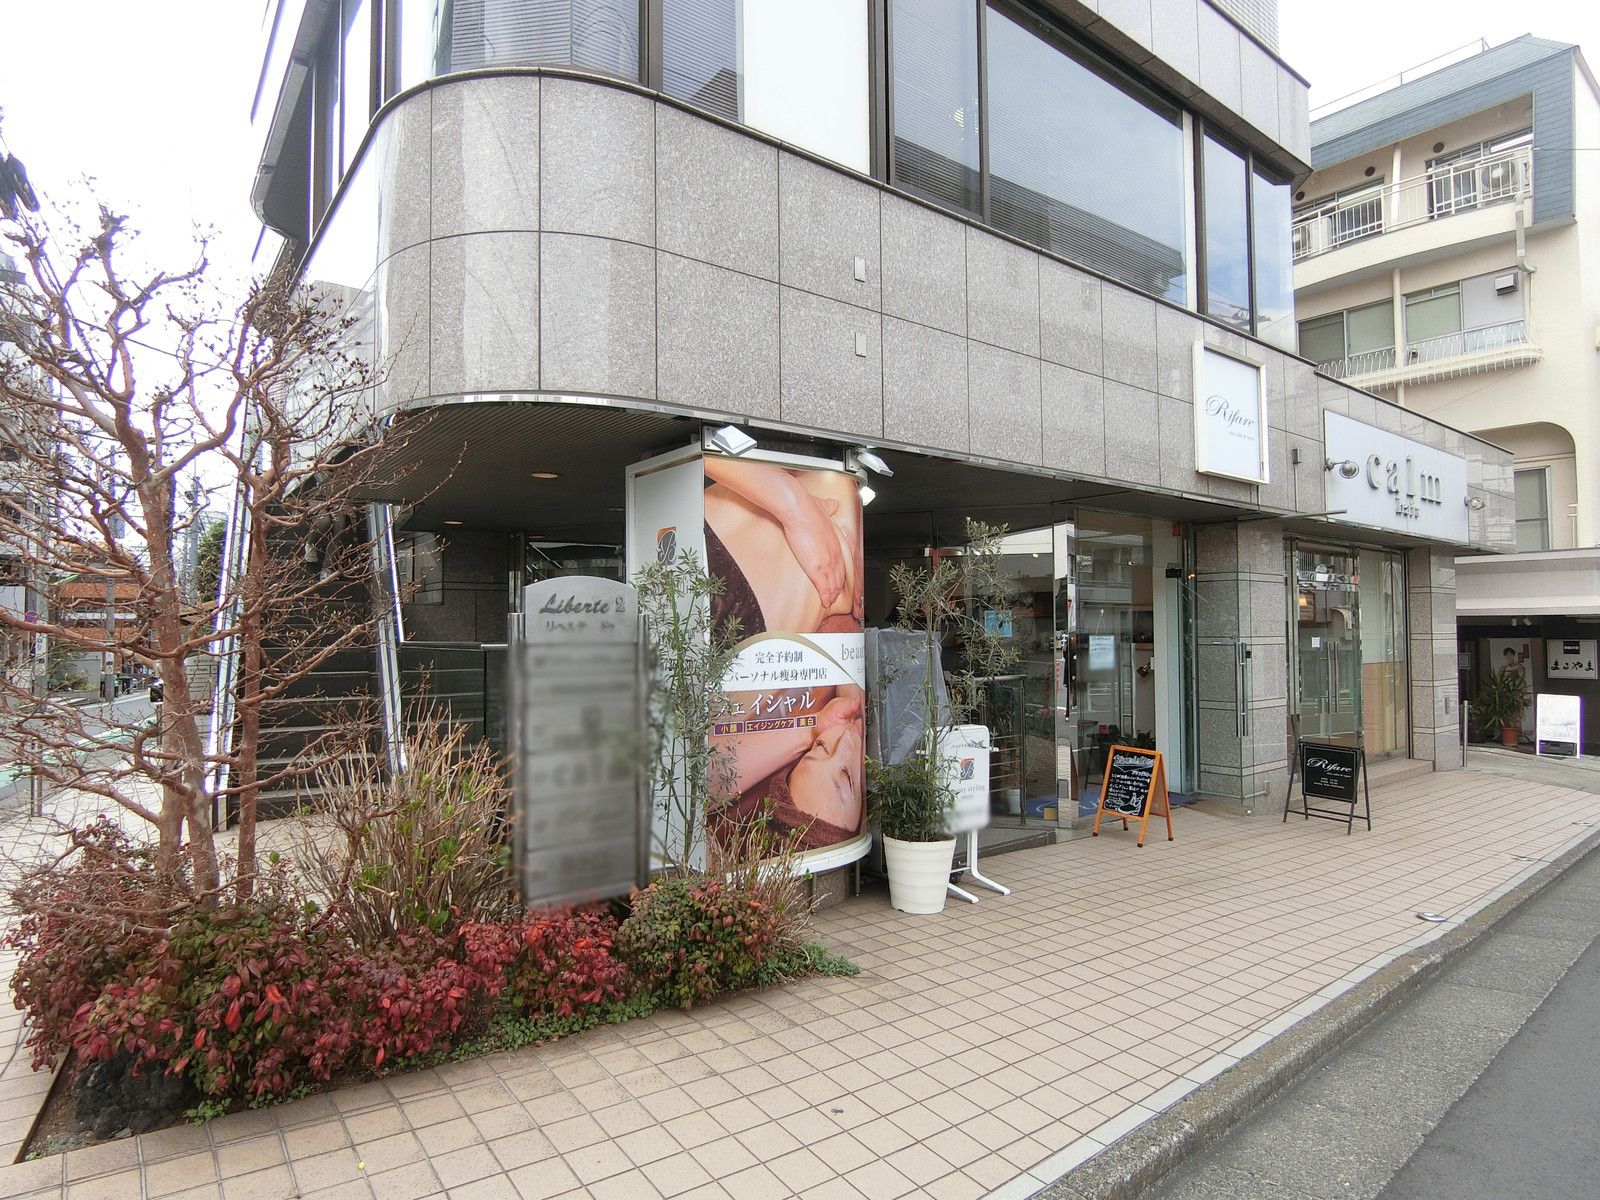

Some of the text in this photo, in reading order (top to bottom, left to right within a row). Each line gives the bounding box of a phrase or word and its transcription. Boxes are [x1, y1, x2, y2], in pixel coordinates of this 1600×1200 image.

[538, 593, 609, 614] Liberte
[755, 650, 803, 665] 完全予約制
[729, 667, 828, 683] パーソナル痩身専門店
[747, 719, 794, 731] エイジングケア
